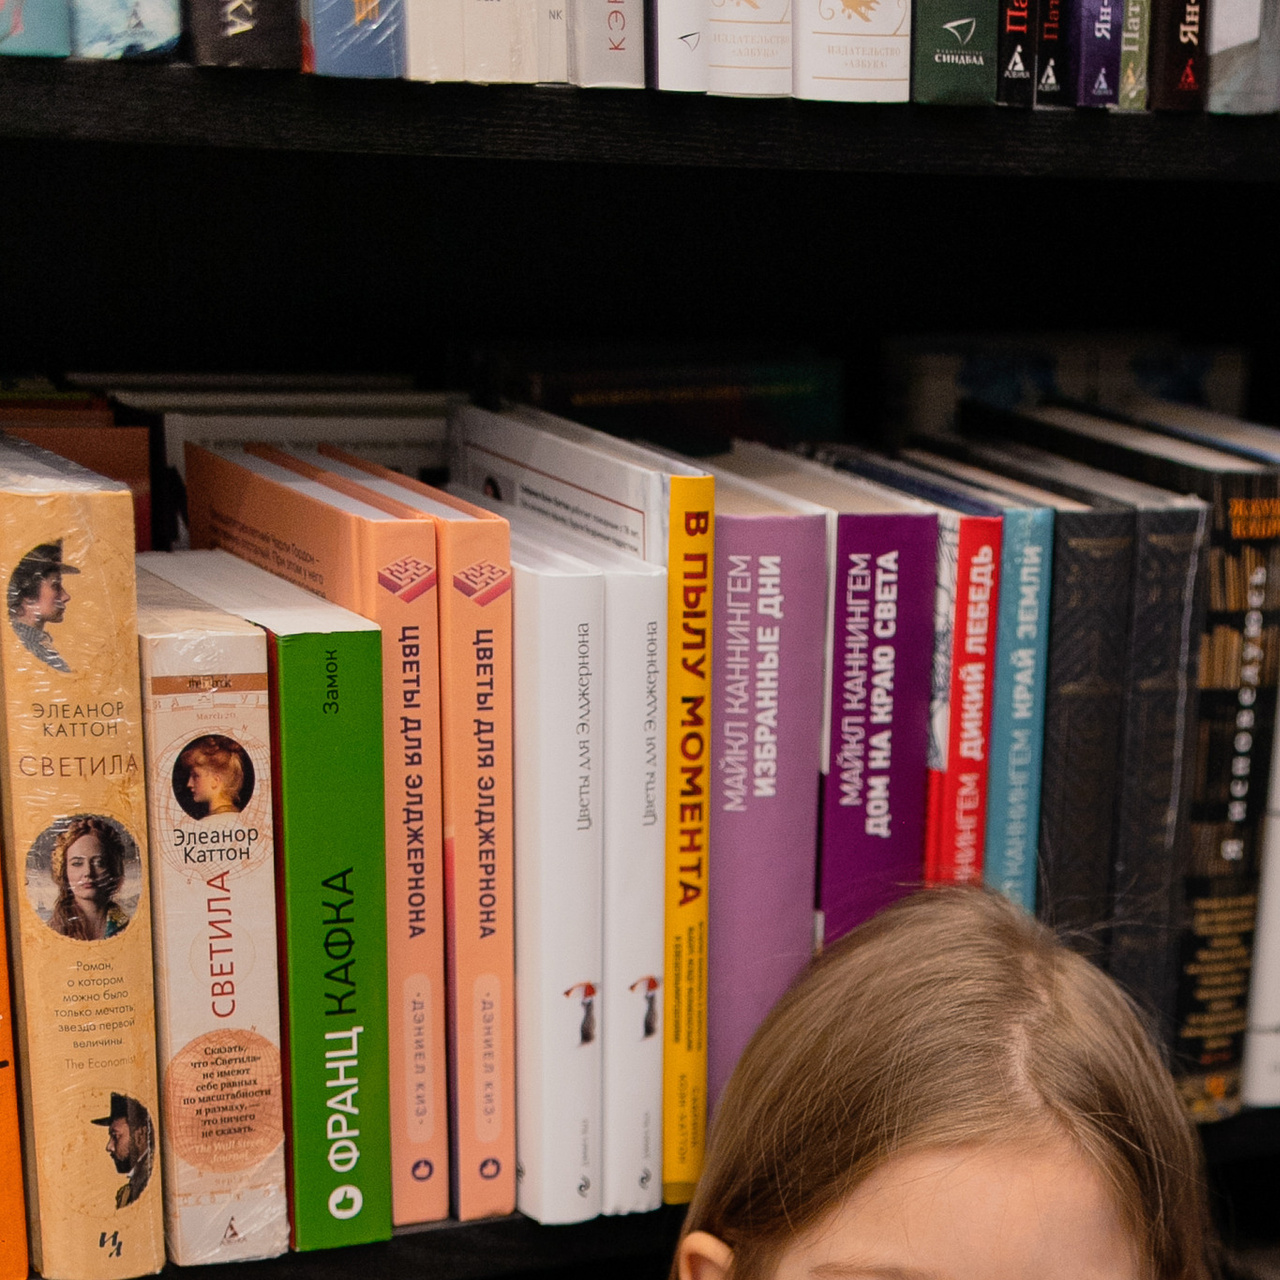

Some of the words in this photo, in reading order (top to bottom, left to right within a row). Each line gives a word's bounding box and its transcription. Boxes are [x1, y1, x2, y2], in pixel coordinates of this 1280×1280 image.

[608, 0, 626, 51] КЭ
[934, 53, 985, 66] СИНДБАД
[684, 509, 711, 537] В
[757, 555, 783, 620] ДНИ
[873, 549, 899, 639] СВЕТА
[965, 544, 994, 655] ЛЕБЕДЬ
[1016, 545, 1043, 641] ЗЕМЛИ
[682, 552, 710, 681] ПЫЛУ
[724, 554, 752, 716] КАННИНГЕМ
[843, 552, 872, 710] КАННИНГЕМ
[322, 649, 339, 715] Замок
[398, 625, 422, 709] ЦВЕТЫ
[472, 628, 494, 711] ЦВЕТЫ
[870, 644, 896, 724] КРАЮ
[1012, 646, 1037, 720] КРАЙ
[31, 701, 125, 718] ЭЛЕАНОР
[43, 722, 118, 737] КАТТОН
[753, 625, 781, 798] ИЗБРАННЫЕ
[958, 662, 986, 762] ДИКИЙ
[19, 753, 139, 777] СВЕТИЛА
[400, 716, 423, 767] ДЛЯ
[474, 718, 495, 768] ДЛЯ
[578, 738, 591, 770] для
[643, 737, 658, 767] для
[719, 721, 749, 813] МАЙКЛ
[836, 716, 866, 806] МАЙКЛ
[868, 730, 893, 769] НА
[576, 775, 592, 831] Цветы
[641, 771, 657, 828] Цветы
[678, 695, 706, 907] МОМЕНТА
[865, 774, 892, 839] ДОМ
[173, 828, 259, 846] Элеанор
[183, 846, 250, 864] Каттон
[403, 773, 427, 939] ЭЛДЖЕРНОНА
[475, 773, 497, 939] ЭЛДЖЕРНОНА
[76, 960, 114, 971] Роман,
[206, 870, 236, 1018] СВЕТИЛА
[321, 866, 357, 1017] КАФКА
[62, 993, 101, 1002] можно
[103, 989, 129, 1000] было
[78, 976, 124, 988] котором
[54, 1008, 93, 1017] только
[58, 1022, 97, 1033] звезда
[99, 1018, 136, 1032] первой
[412, 998, 428, 1075] ДЭНИЕЛ
[481, 998, 495, 1074] ДЭНИЕЛ
[65, 1058, 85, 1070] The
[190, 1060, 209, 1069] что
[202, 1072, 215, 1080] не
[217, 1068, 251, 1078] имеют
[204, 1045, 247, 1056] Сказать,
[183, 1098, 196, 1106] по
[198, 1088, 271, 1103] масштабности
[195, 1081, 218, 1092] себе
[220, 1079, 258, 1091] равных
[195, 1108, 202, 1116] и
[205, 1103, 248, 1117] размаху,
[324, 1025, 365, 1173] ФРАНЦ
[414, 1081, 428, 1118] КИЗ
[483, 1080, 496, 1117] КИЗ
[200, 1118, 218, 1127] это
[220, 1113, 255, 1124] ничего
[201, 1130, 214, 1139] не
[215, 1125, 256, 1136] сказать.
